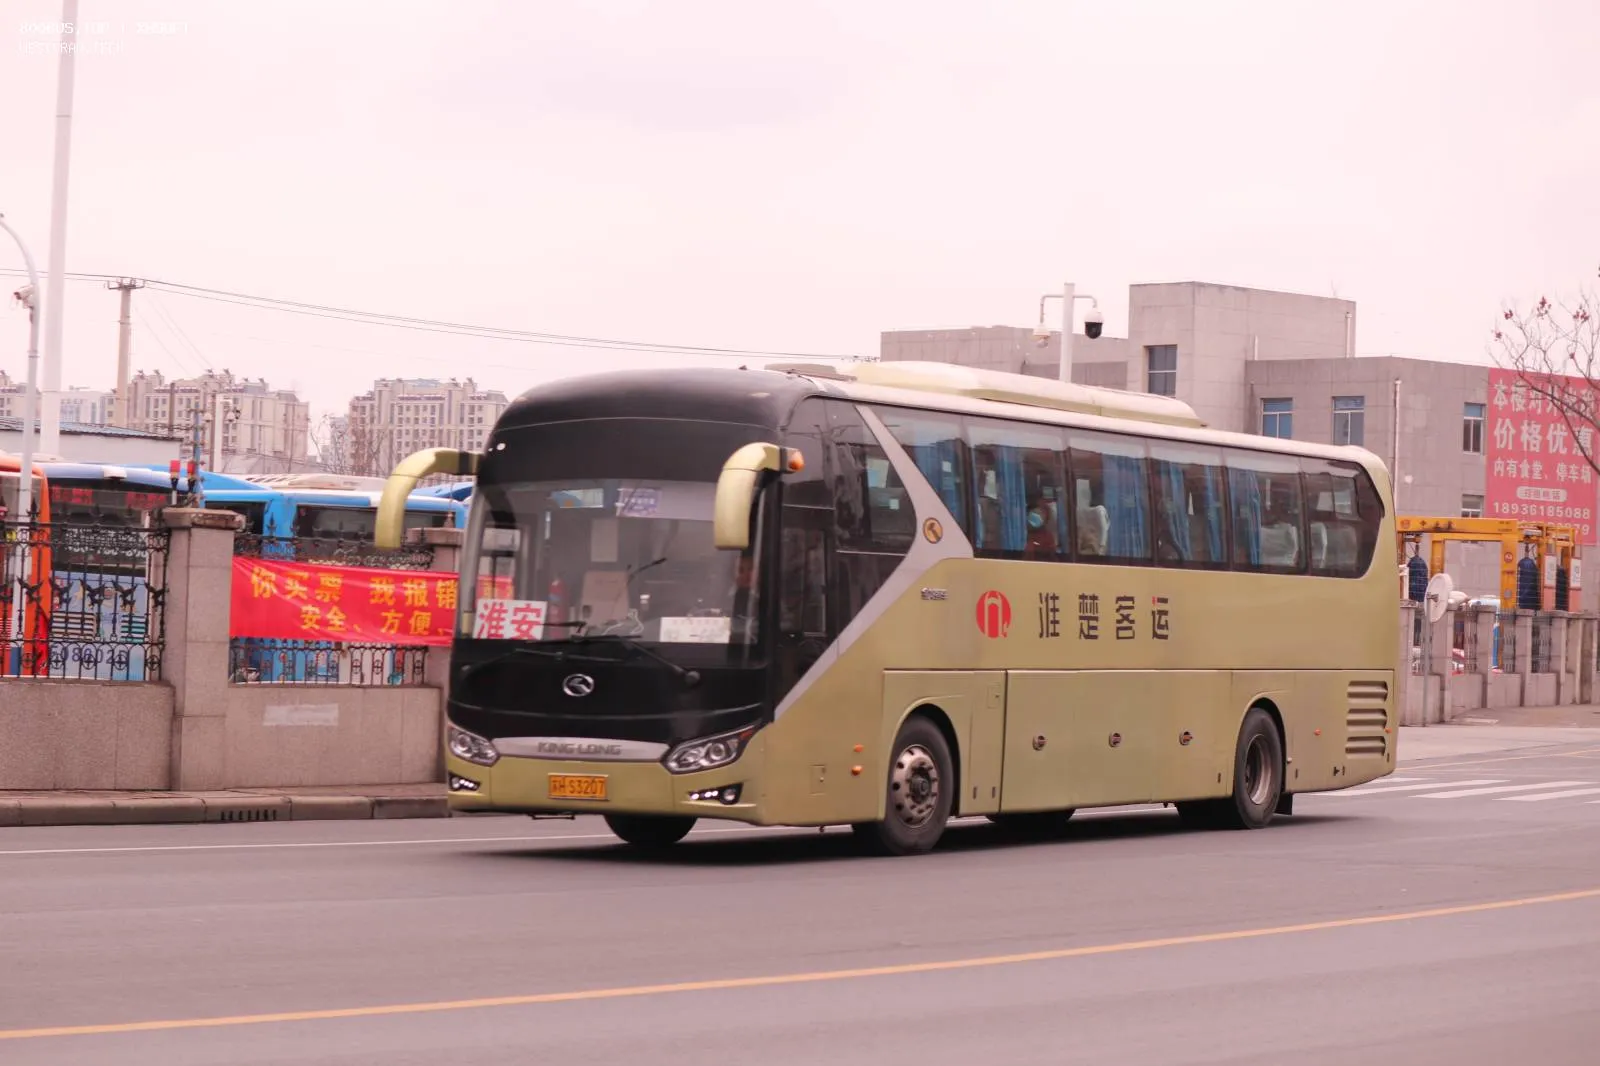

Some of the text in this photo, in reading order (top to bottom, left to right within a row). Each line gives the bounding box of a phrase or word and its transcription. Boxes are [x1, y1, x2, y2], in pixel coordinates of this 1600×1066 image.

[1494, 418, 1593, 457] 价格优惠
[251, 566, 344, 602] 你买票
[369, 576, 458, 609] 我报销
[477, 602, 543, 640] 淮安
[1038, 592, 1170, 641] 淮楚客运
[538, 742, 622, 755] KING LONG
